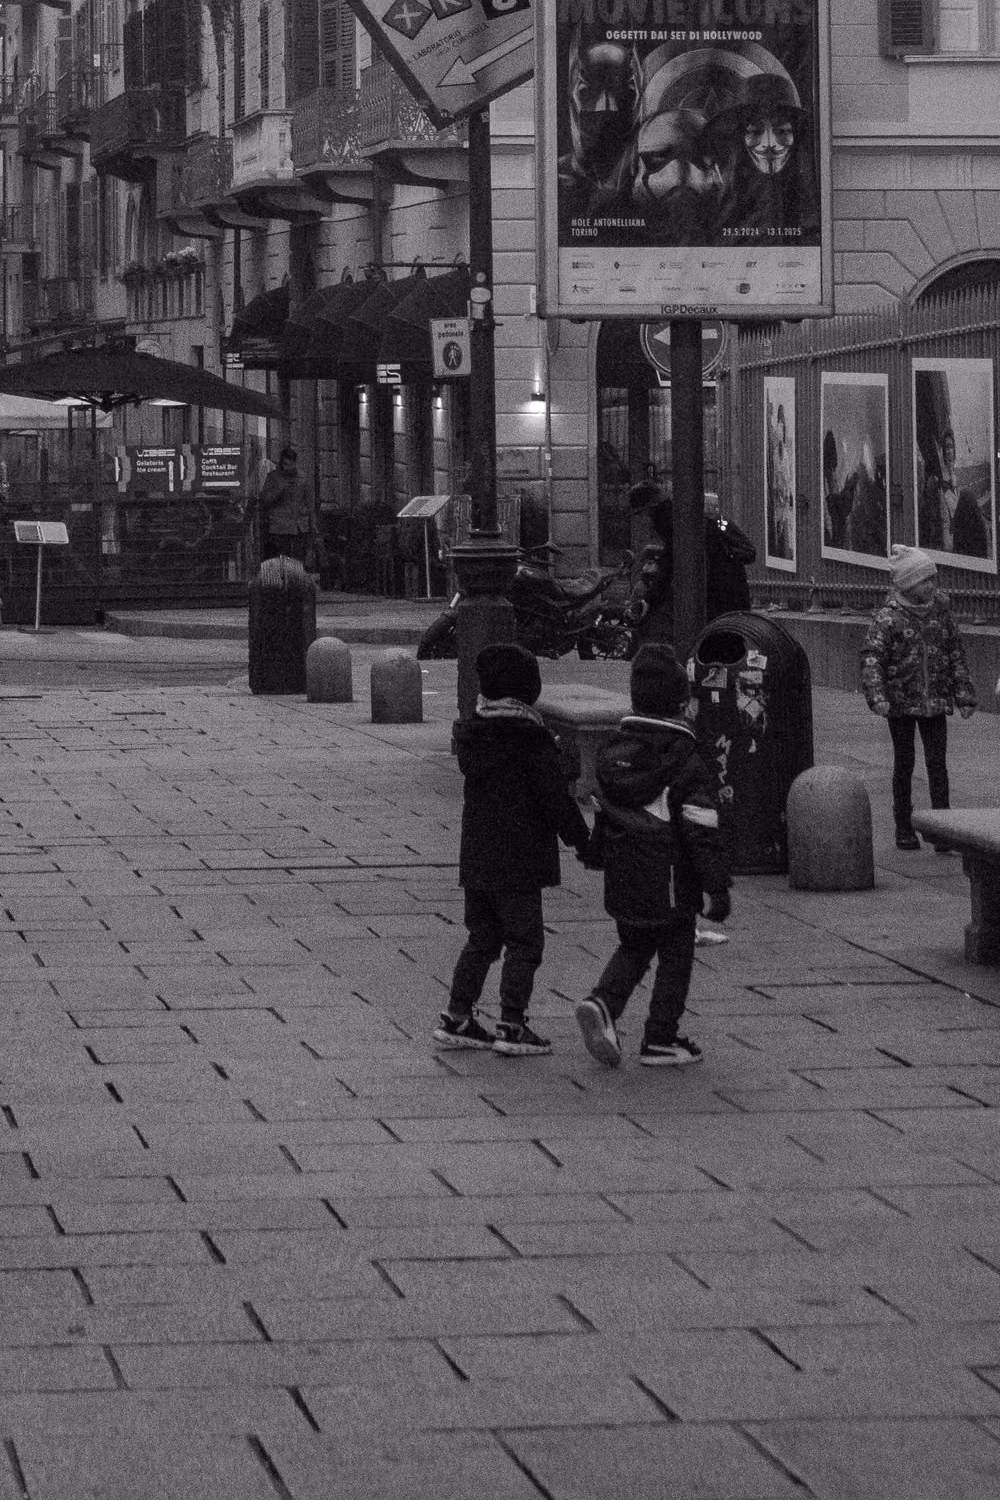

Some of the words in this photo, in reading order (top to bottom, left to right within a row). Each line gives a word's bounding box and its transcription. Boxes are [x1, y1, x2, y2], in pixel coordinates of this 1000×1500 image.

[606, 31, 647, 40] OGGETTI
[651, 31, 667, 40] DAI
[670, 31, 686, 40] SET
[689, 31, 699, 40] DI
[703, 31, 762, 40] HOLLYWOOD
[412, 30, 461, 60] LABORATORIO
[571, 218, 590, 227] MOLE
[594, 218, 646, 227] ANTONELLIANA
[571, 228, 598, 236] TORINO
[723, 228, 759, 236] 29.5.2024
[767, 228, 802, 236] 13.1.2025
[661, 304, 717, 314] IGPDecaux
